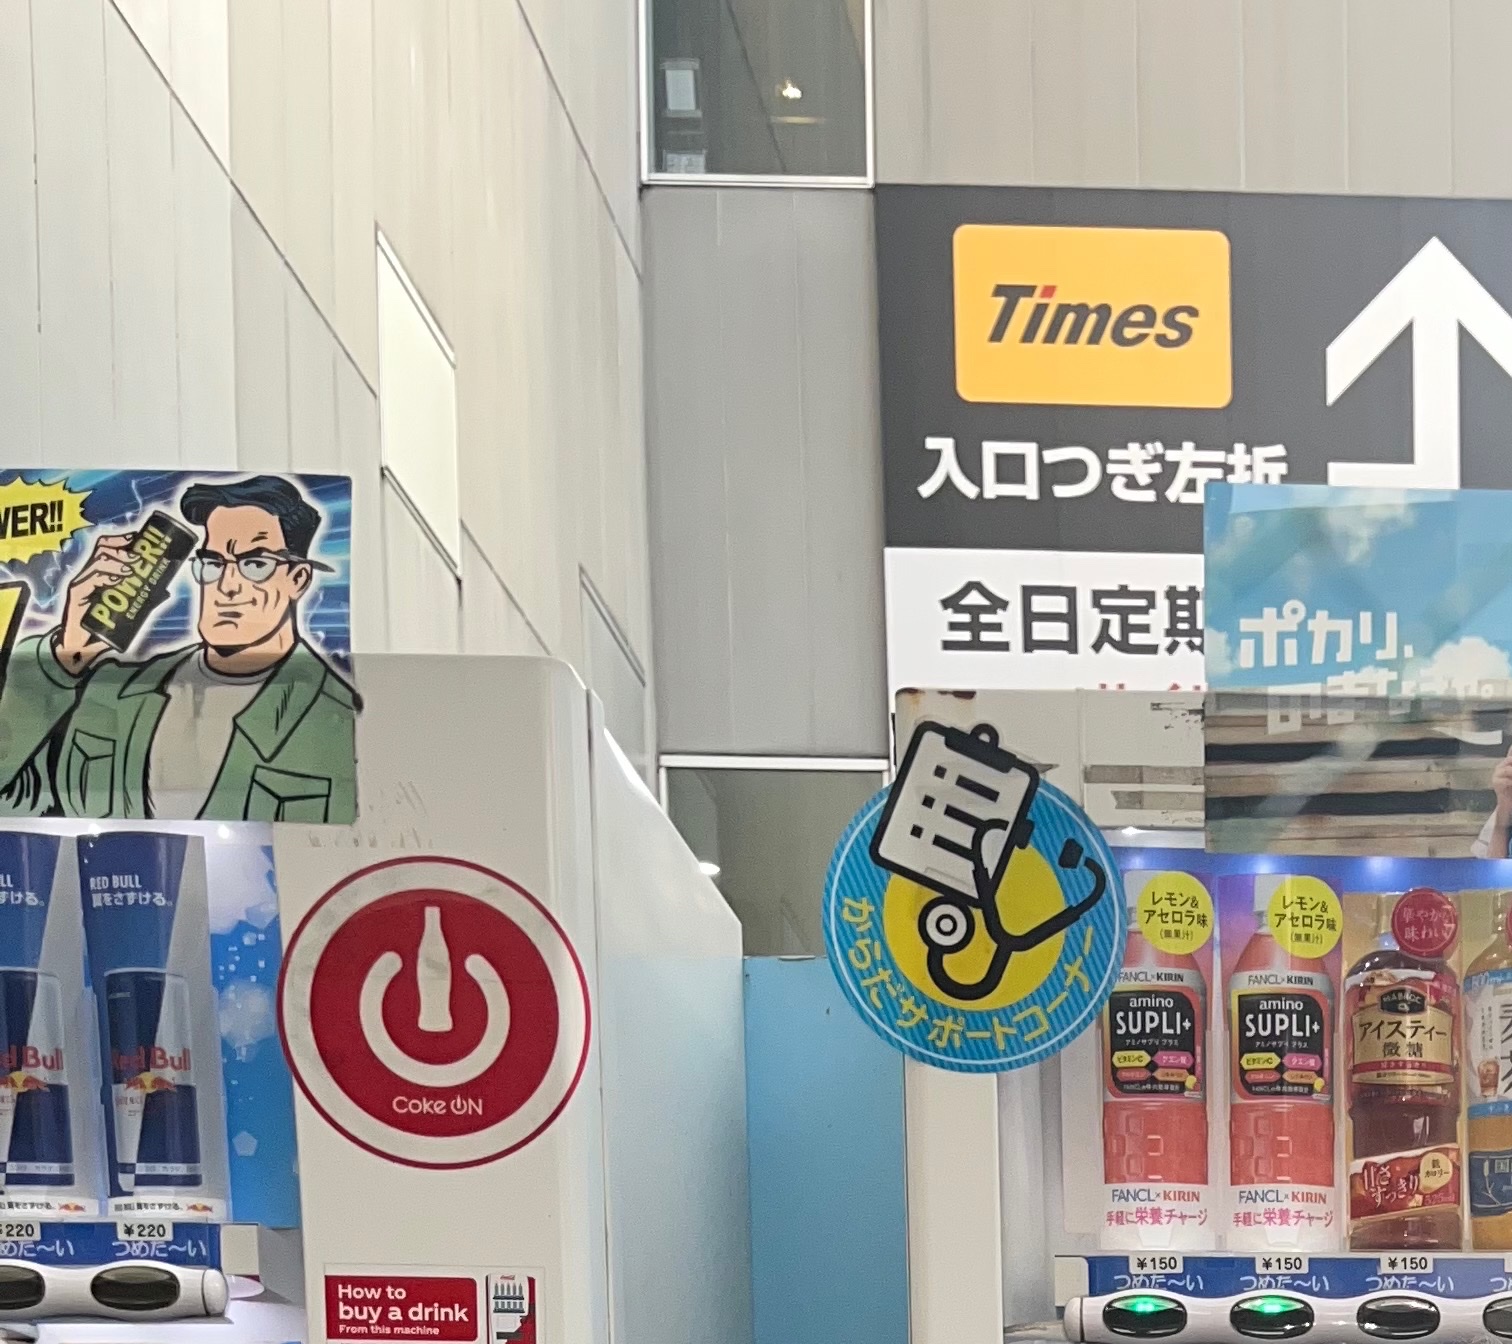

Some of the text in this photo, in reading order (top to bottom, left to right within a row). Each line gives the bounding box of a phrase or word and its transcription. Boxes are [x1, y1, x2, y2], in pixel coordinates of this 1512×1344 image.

[988, 284, 1199, 348] Times
[113, 874, 142, 889] BULL
[1152, 892, 1198, 907] レモン&
[1143, 910, 1208, 928] アセロラ味
[842, 898, 1093, 1048] からだサポートコーナー
[1129, 997, 1174, 1008] amino
[1259, 998, 1304, 1011] amino
[1116, 1011, 1192, 1035] SUPLI+
[1245, 1015, 1320, 1037] SUPLI+
[1359, 1017, 1446, 1041] アイスティー
[1382, 1042, 1424, 1058] 微糖
[392, 1092, 484, 1117] Coke ON
[1112, 1188, 1200, 1202] FANCL KIRIN
[123, 1224, 166, 1238] ¥220
[1136, 1257, 1178, 1270] ¥150
[337, 1284, 406, 1299] How to
[338, 1302, 469, 1322] buy a drink
[338, 1324, 440, 1335] From this machine
